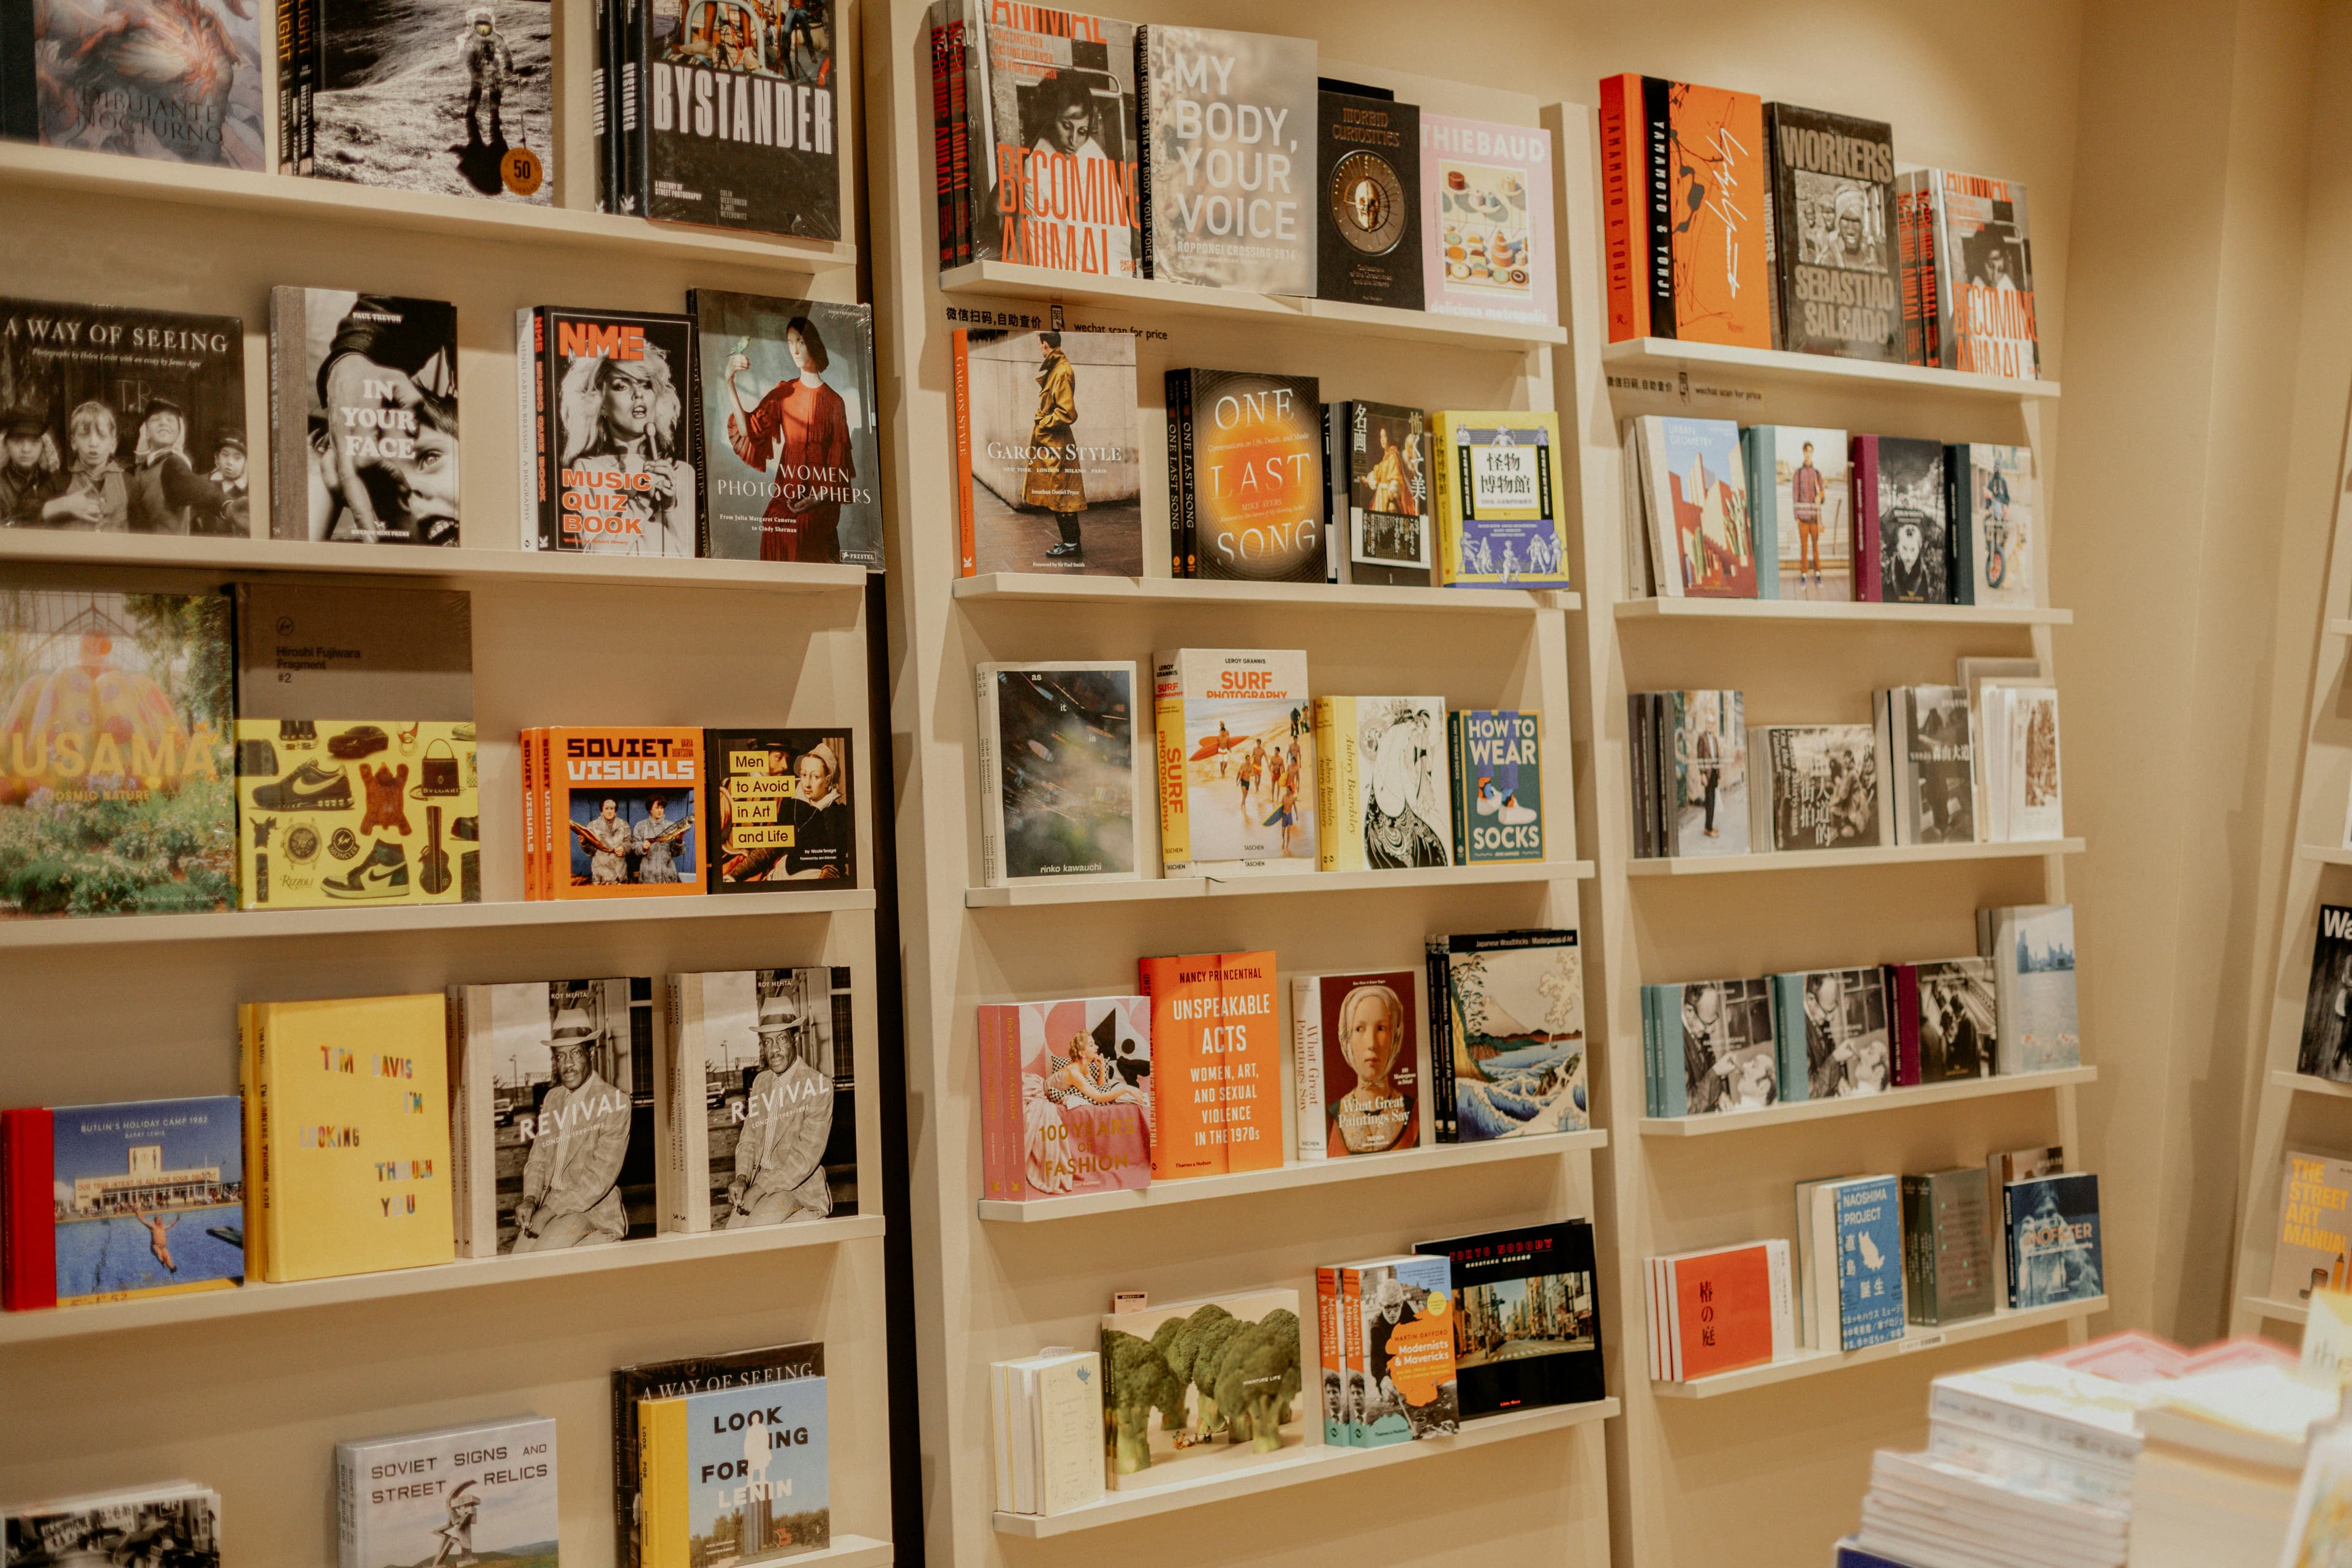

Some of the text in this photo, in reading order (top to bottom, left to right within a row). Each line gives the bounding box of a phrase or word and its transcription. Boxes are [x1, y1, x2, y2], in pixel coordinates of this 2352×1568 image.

[1175, 54, 1235, 96] MY
[82, 89, 216, 122] DIBUJANTE
[654, 62, 831, 154] BYSTANDER
[1343, 107, 1389, 127] MORBID
[77, 110, 223, 145] NOCTURNO
[1177, 100, 1297, 153] BODY,
[1332, 124, 1400, 147] CURIOSITIES
[1420, 124, 1545, 164] THIEBAUD
[1781, 126, 1892, 184] WORKERS
[513, 160, 530, 179] 50
[1177, 146, 1291, 194] YOUR
[1653, 121, 1667, 214] YAMAMOTO
[671, 190, 702, 201] PHOTOGRAPHY
[997, 145, 1140, 230] BECOMING
[1177, 195, 1297, 241] VOICE
[1177, 241, 1295, 260] ROPPONGI CROSSING 2016
[1656, 246, 1669, 298] YOHJI
[946, 307, 1041, 330] 微信扫码,自助查价
[1804, 301, 1888, 344] SALGADO
[4, 320, 228, 352] A WAY OF SEEING
[559, 322, 644, 361] NME
[1074, 321, 1105, 333] wechat
[1145, 329, 1167, 340] price
[363, 380, 394, 401] IN
[341, 407, 416, 430] YOUR
[1215, 388, 1294, 430] ONE
[1353, 404, 1367, 453] 名画
[344, 435, 415, 459] FACE
[987, 442, 1121, 465] GARÇON STYLE
[780, 464, 850, 483] WOMEN
[1487, 454, 1520, 472] 怪物
[563, 469, 652, 491] MUSIC
[1210, 453, 1310, 499] LAST
[1480, 474, 1531, 494] 博物館
[563, 492, 628, 512] QUIZ
[717, 480, 871, 504] PHOTOGRAPHERS
[564, 514, 643, 535] BOOK
[749, 516, 772, 524] Margaret
[1217, 519, 1316, 565] SONG
[276, 647, 361, 660] Hiroshi Fujiwara
[276, 658, 326, 671] Fragment
[278, 673, 292, 683] #2
[1221, 671, 1272, 690] SURF
[1469, 719, 1534, 739] HOW TO
[0, 732, 217, 778] USAMA
[567, 739, 673, 758] SOVIET
[1470, 739, 1536, 766] WEAR
[567, 761, 695, 780] VISUALS
[736, 756, 764, 768] Men
[737, 780, 790, 792] to Avoid
[1168, 748, 1183, 813] SURF
[738, 806, 771, 818] in Art
[739, 830, 788, 843] and Life
[1473, 826, 1539, 850] SOCKS
[329, 846, 360, 861] MONCLER
[1063, 862, 1101, 873] kawauchi
[1476, 938, 1529, 949] Japanese Woodblocks
[1180, 968, 1262, 983] NANCY PRINCENTHAL
[1173, 993, 1270, 1020] UNSPEAKABLE
[1202, 1025, 1246, 1054] ACTS
[320, 1046, 413, 1080] TIM DAVIS
[1191, 1063, 1259, 1082] WOMEN, ART,
[731, 1074, 831, 1123] REVIVAL
[1194, 1084, 1256, 1104] AND SEXUAL
[1343, 1096, 1404, 1113] What Great
[81, 1122, 119, 1133] BUTLIN'S
[123, 1120, 160, 1130] HOLIDAY
[162, 1117, 187, 1127] CAMP
[519, 1089, 628, 1142] REVIVAL
[1201, 1106, 1251, 1124] VIOLENCE
[1338, 1109, 1410, 1128] Paintings Say
[300, 1125, 360, 1149] LOOKING
[1039, 1116, 1135, 1144] 100 YEARS
[1195, 1126, 1260, 1146] IN THE 1970s
[1077, 1142, 1092, 1153] OF
[375, 1159, 432, 1183] THROUGH
[1045, 1153, 1128, 1177] FASHION
[2293, 1158, 2326, 1183] THE
[381, 1194, 415, 1218] YOU
[1844, 1189, 1887, 1207] NAOSHIMA
[2289, 1180, 2349, 1210] STREET
[1844, 1208, 1882, 1226] PROJECT
[2285, 1202, 2321, 1226] ART
[1449, 1238, 1553, 1261] TOKYO NOBODY
[2283, 1223, 2347, 1256] MANUAL
[1420, 1329, 1448, 1338] GAYFORD
[1395, 1352, 1449, 1365] & Mavericks
[1399, 1340, 1449, 1354] Modernists
[714, 1407, 783, 1434] LOOK
[371, 1444, 546, 1480] SOVIET SIGNS AND
[701, 1459, 749, 1484] FOR
[372, 1464, 548, 1505] STREET RELICS
[718, 1478, 793, 1508] LENIN
